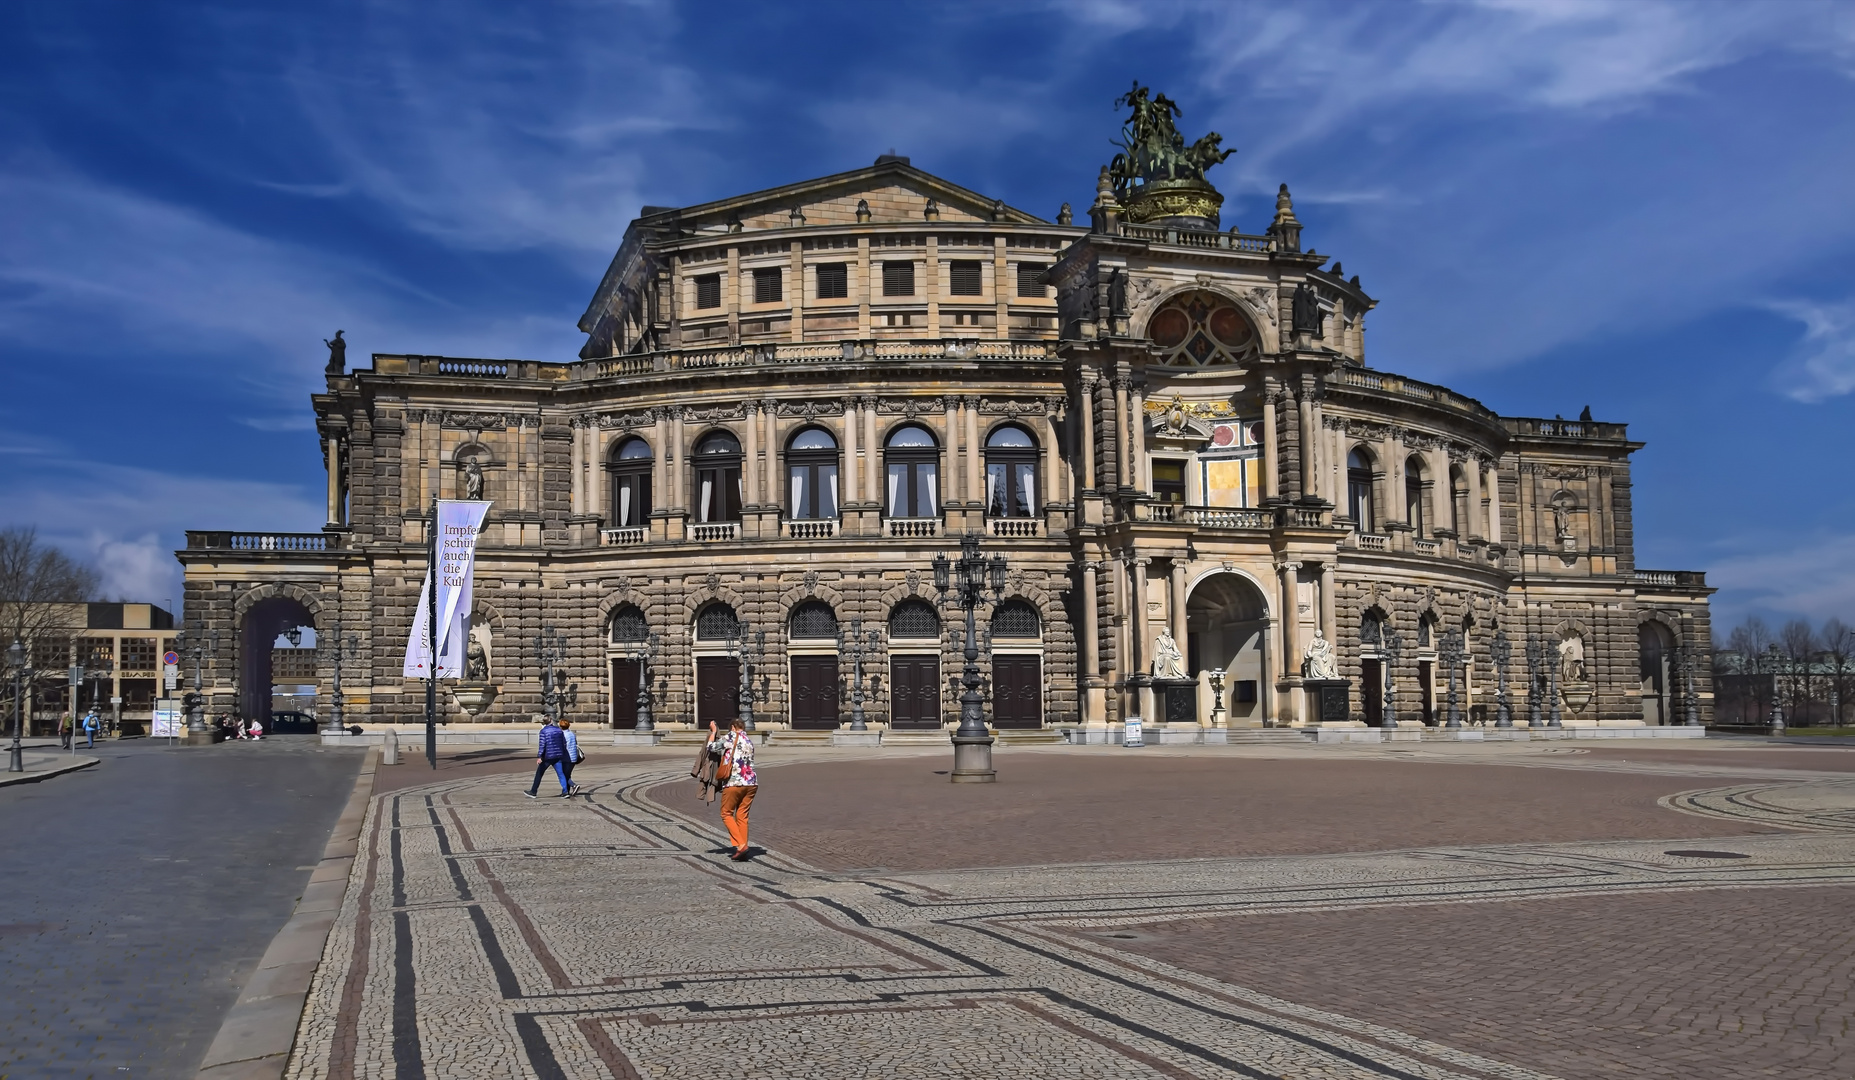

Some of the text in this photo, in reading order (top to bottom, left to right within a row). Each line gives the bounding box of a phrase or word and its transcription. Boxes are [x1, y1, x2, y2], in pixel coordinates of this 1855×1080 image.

[444, 538, 474, 548] schüt
[444, 551, 470, 561] auch
[443, 564, 461, 574] die
